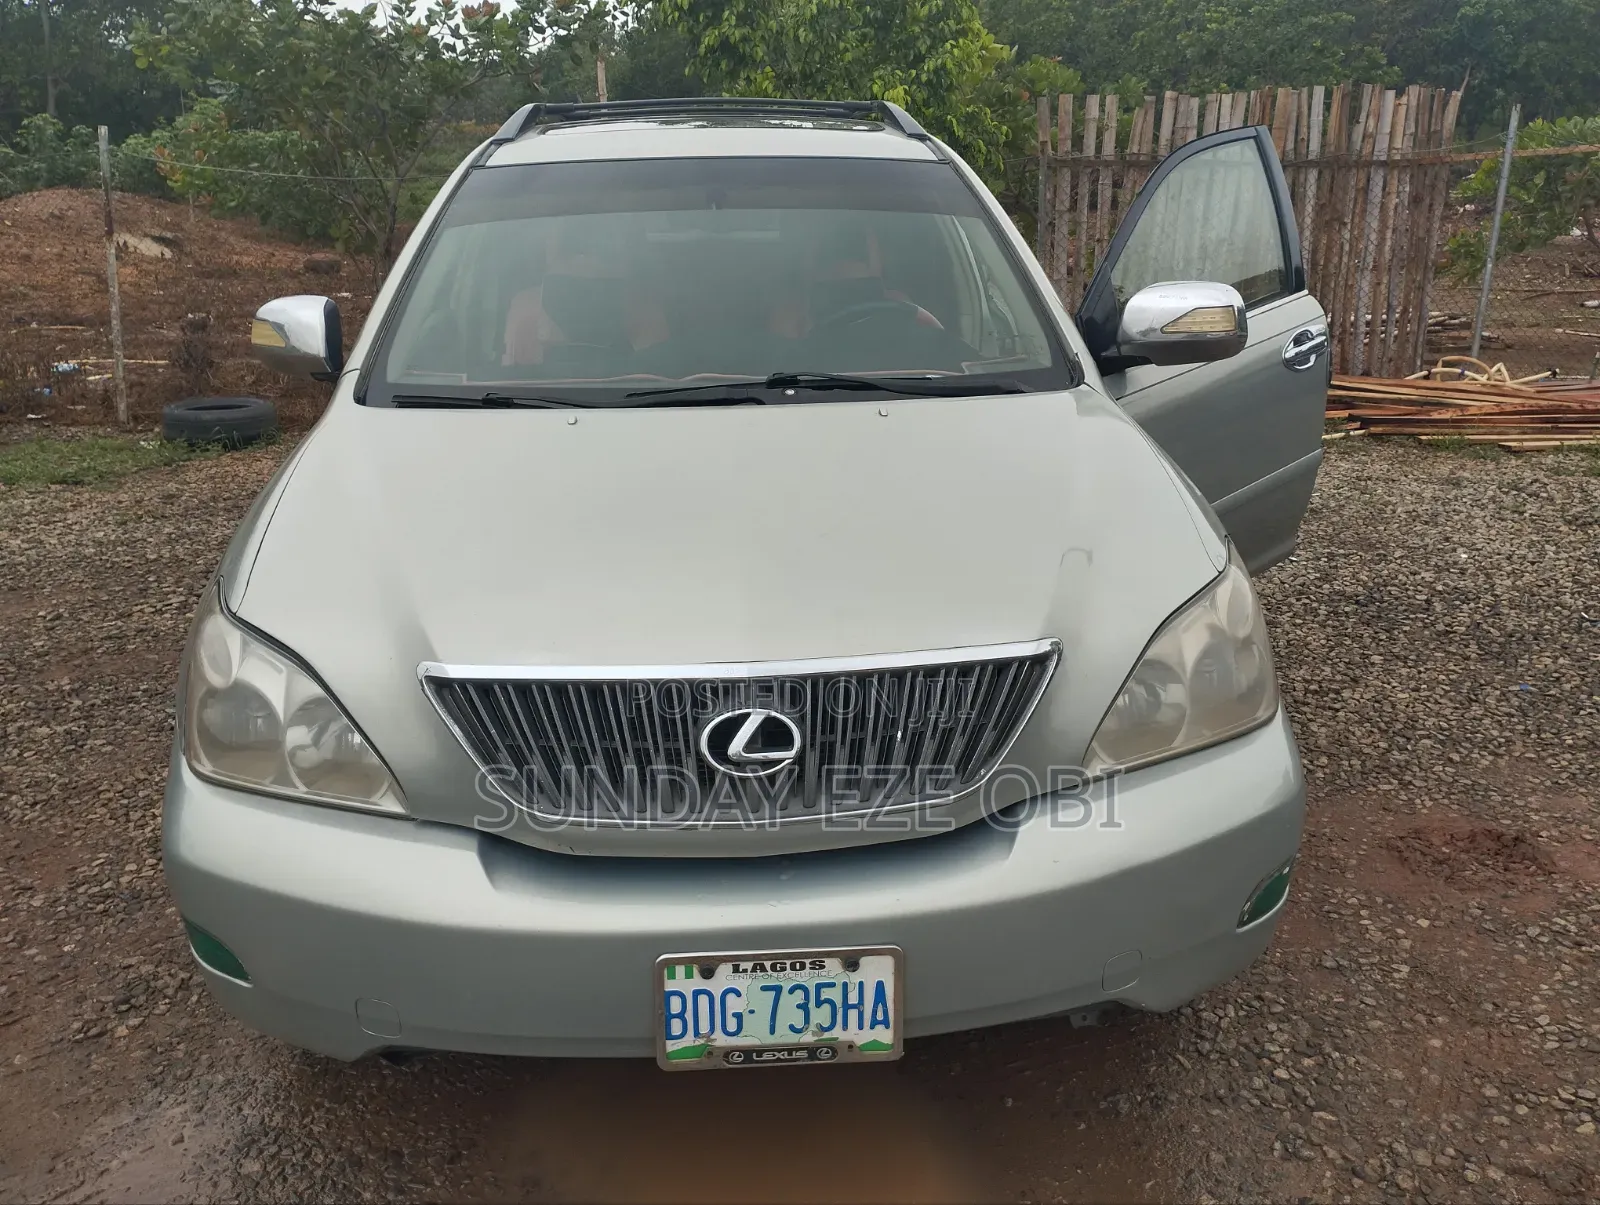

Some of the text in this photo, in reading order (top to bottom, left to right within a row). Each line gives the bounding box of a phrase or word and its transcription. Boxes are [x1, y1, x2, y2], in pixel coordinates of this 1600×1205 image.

[731, 959, 827, 974] LAGOS
[725, 973, 757, 981] CENTRE
[758, 972, 774, 980] OF
[665, 980, 890, 1041] BDG-735HA
[752, 1049, 809, 1061] LEXUS
